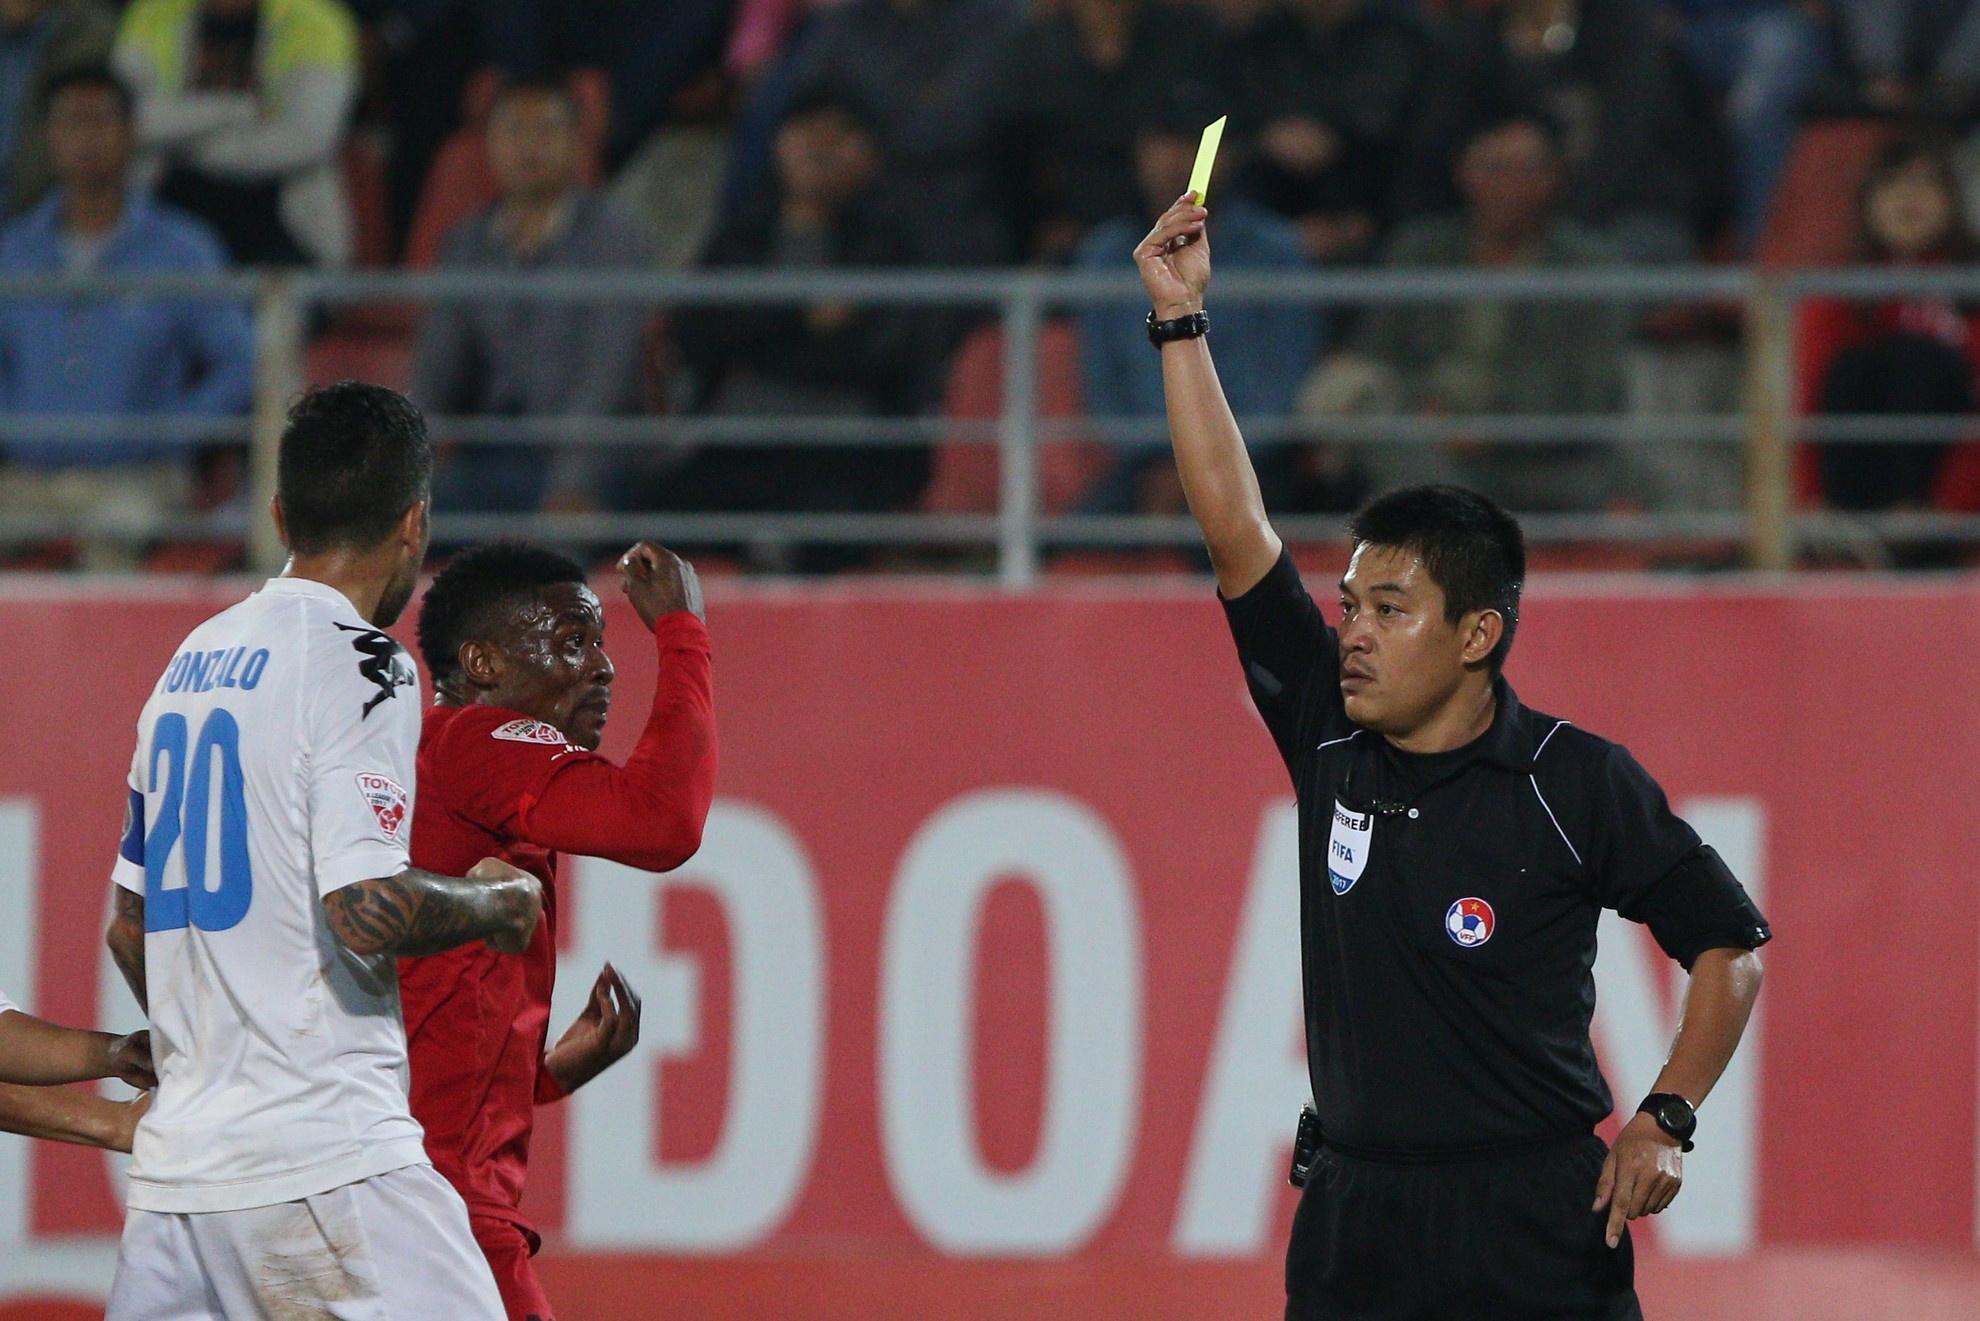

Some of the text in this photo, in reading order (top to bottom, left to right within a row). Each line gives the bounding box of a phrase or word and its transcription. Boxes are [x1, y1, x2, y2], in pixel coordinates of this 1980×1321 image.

[144, 707, 252, 933] 20
[1332, 839, 1354, 864] FIFA
[1460, 933, 1475, 941] VFF
